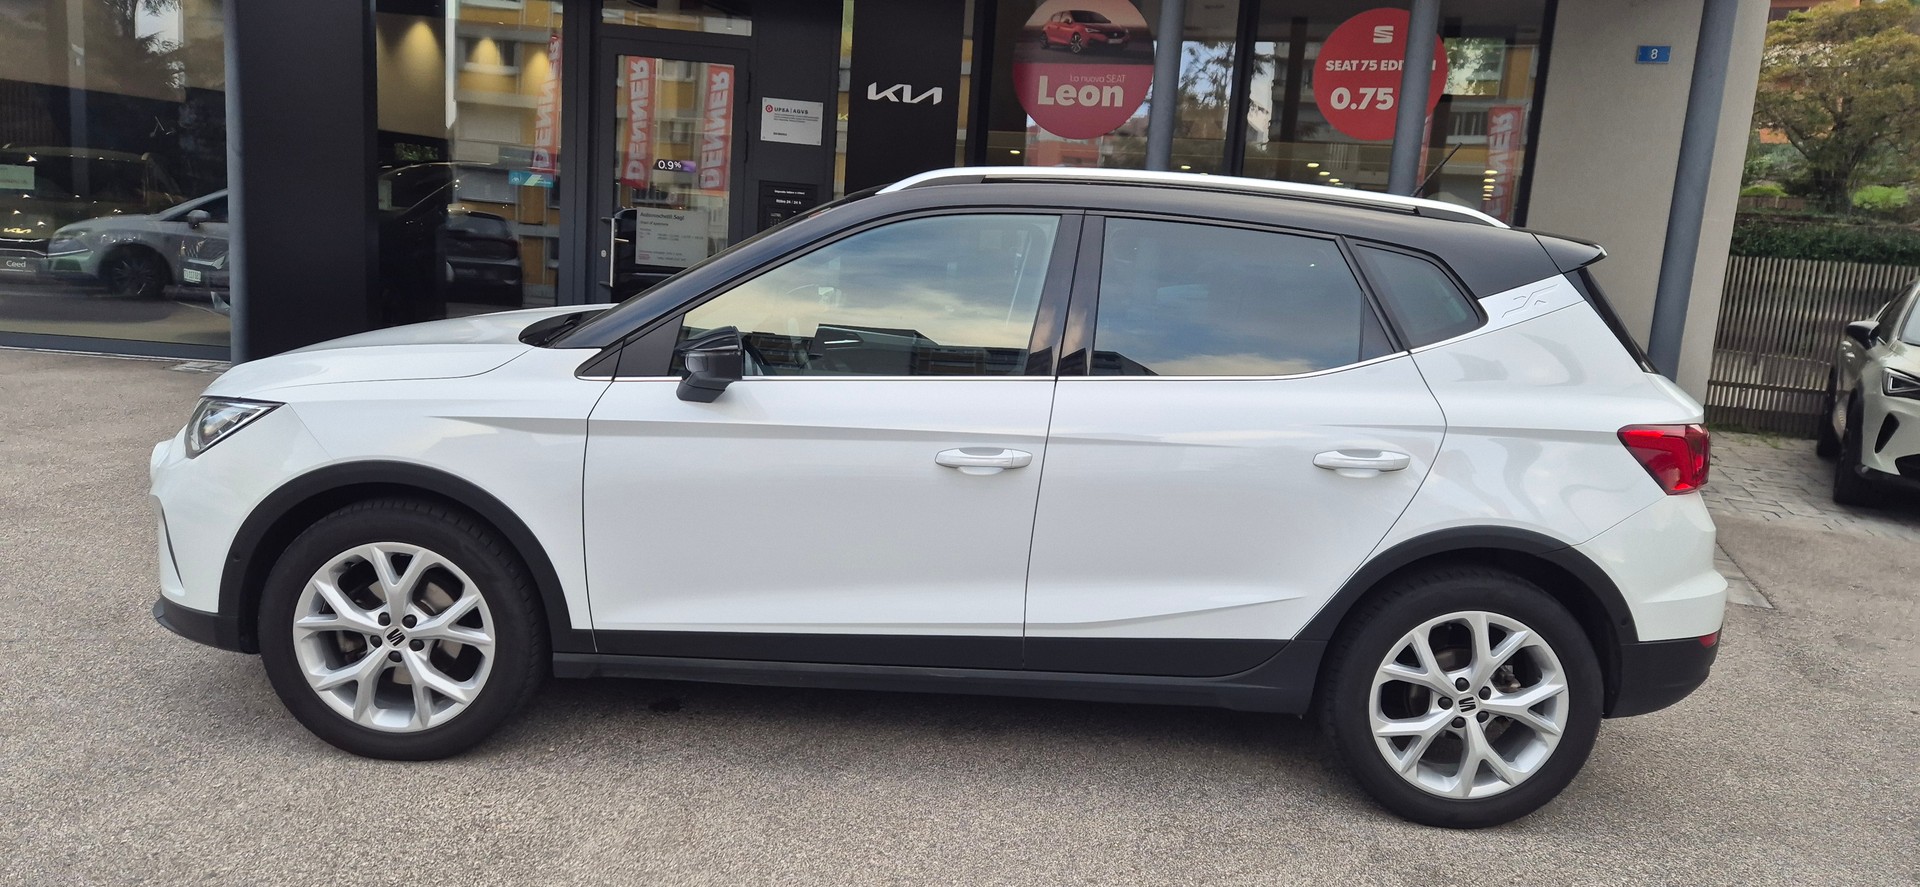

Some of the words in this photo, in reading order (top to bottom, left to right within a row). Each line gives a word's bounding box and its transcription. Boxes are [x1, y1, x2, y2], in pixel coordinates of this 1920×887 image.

[1650, 48, 1659, 60] 8
[1325, 59, 1358, 71] SEAT
[1361, 59, 1378, 71] 75
[1106, 74, 1127, 83] SEAT
[867, 82, 943, 105] KIA
[1037, 75, 1124, 107] Leon
[1330, 87, 1394, 110] 0.75
[658, 159, 682, 170] 0.9%
[6, 260, 26, 268] Ceed
